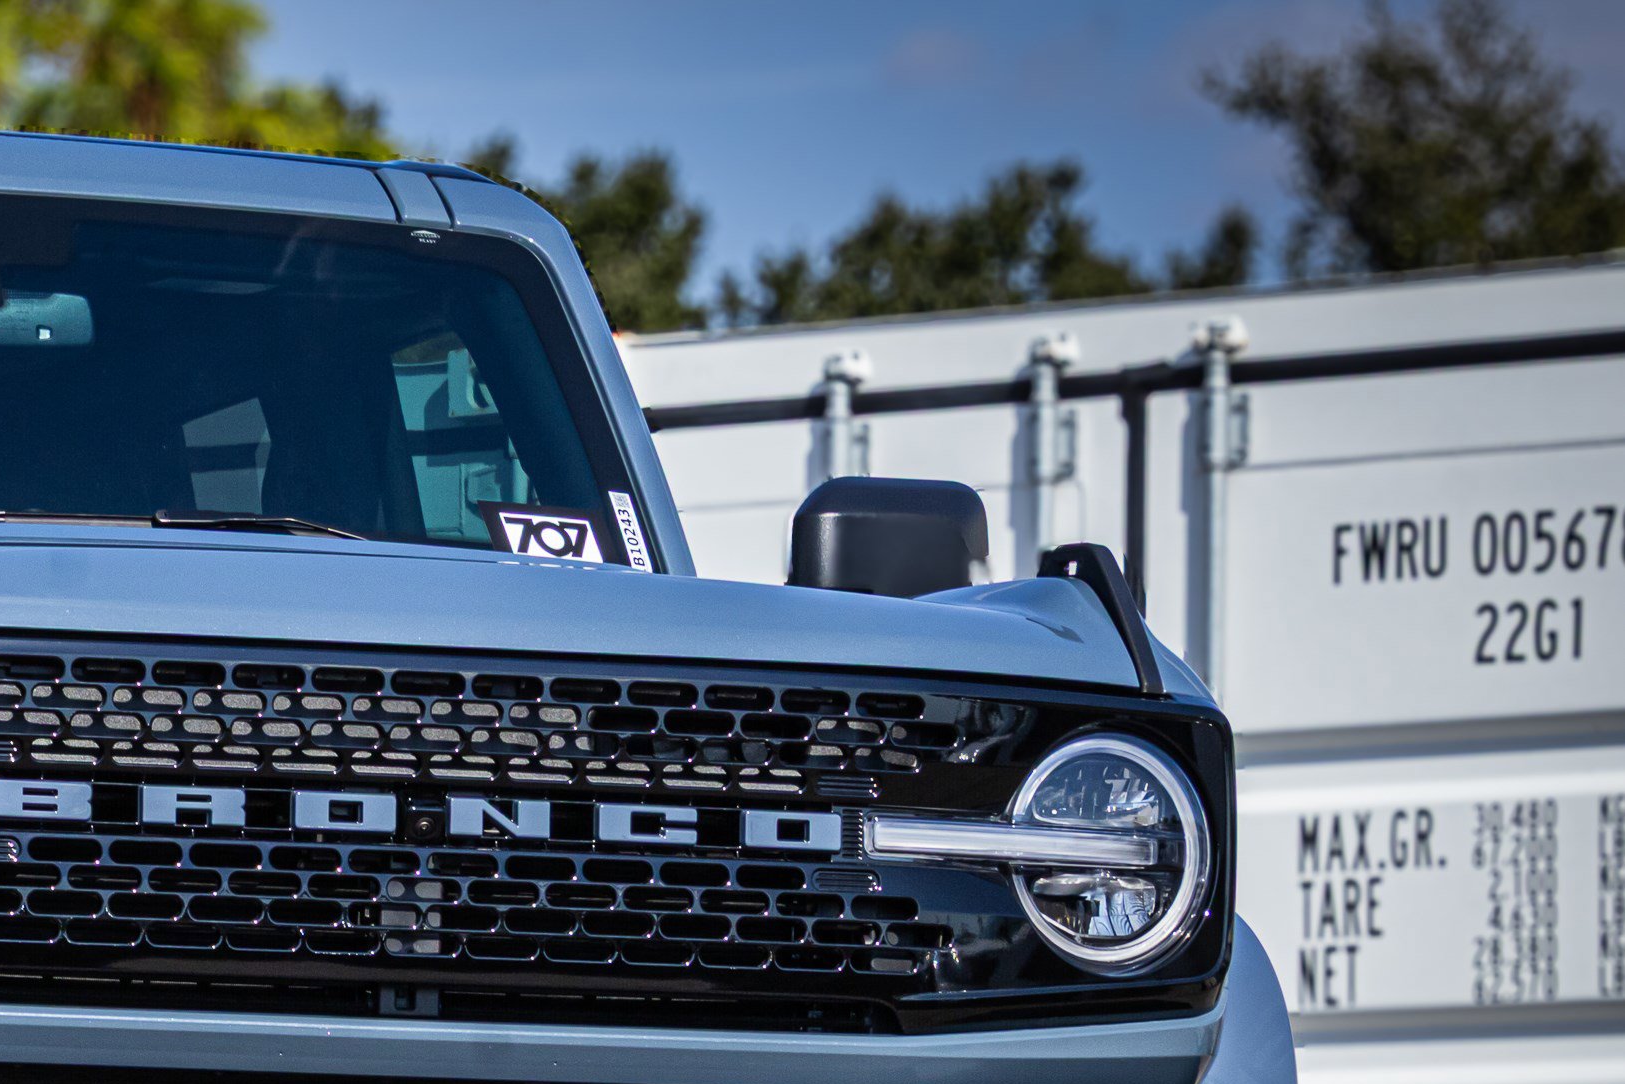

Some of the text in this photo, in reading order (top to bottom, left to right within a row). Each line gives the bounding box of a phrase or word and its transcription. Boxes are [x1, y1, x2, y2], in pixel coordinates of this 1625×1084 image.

[503, 515, 589, 558] 707
[617, 508, 646, 569] B10243
[1332, 504, 1625, 586] FWRU 00567
[1474, 595, 1585, 665] 22G1
[1299, 877, 1384, 939] TARE
[1298, 945, 1362, 1011] NET
